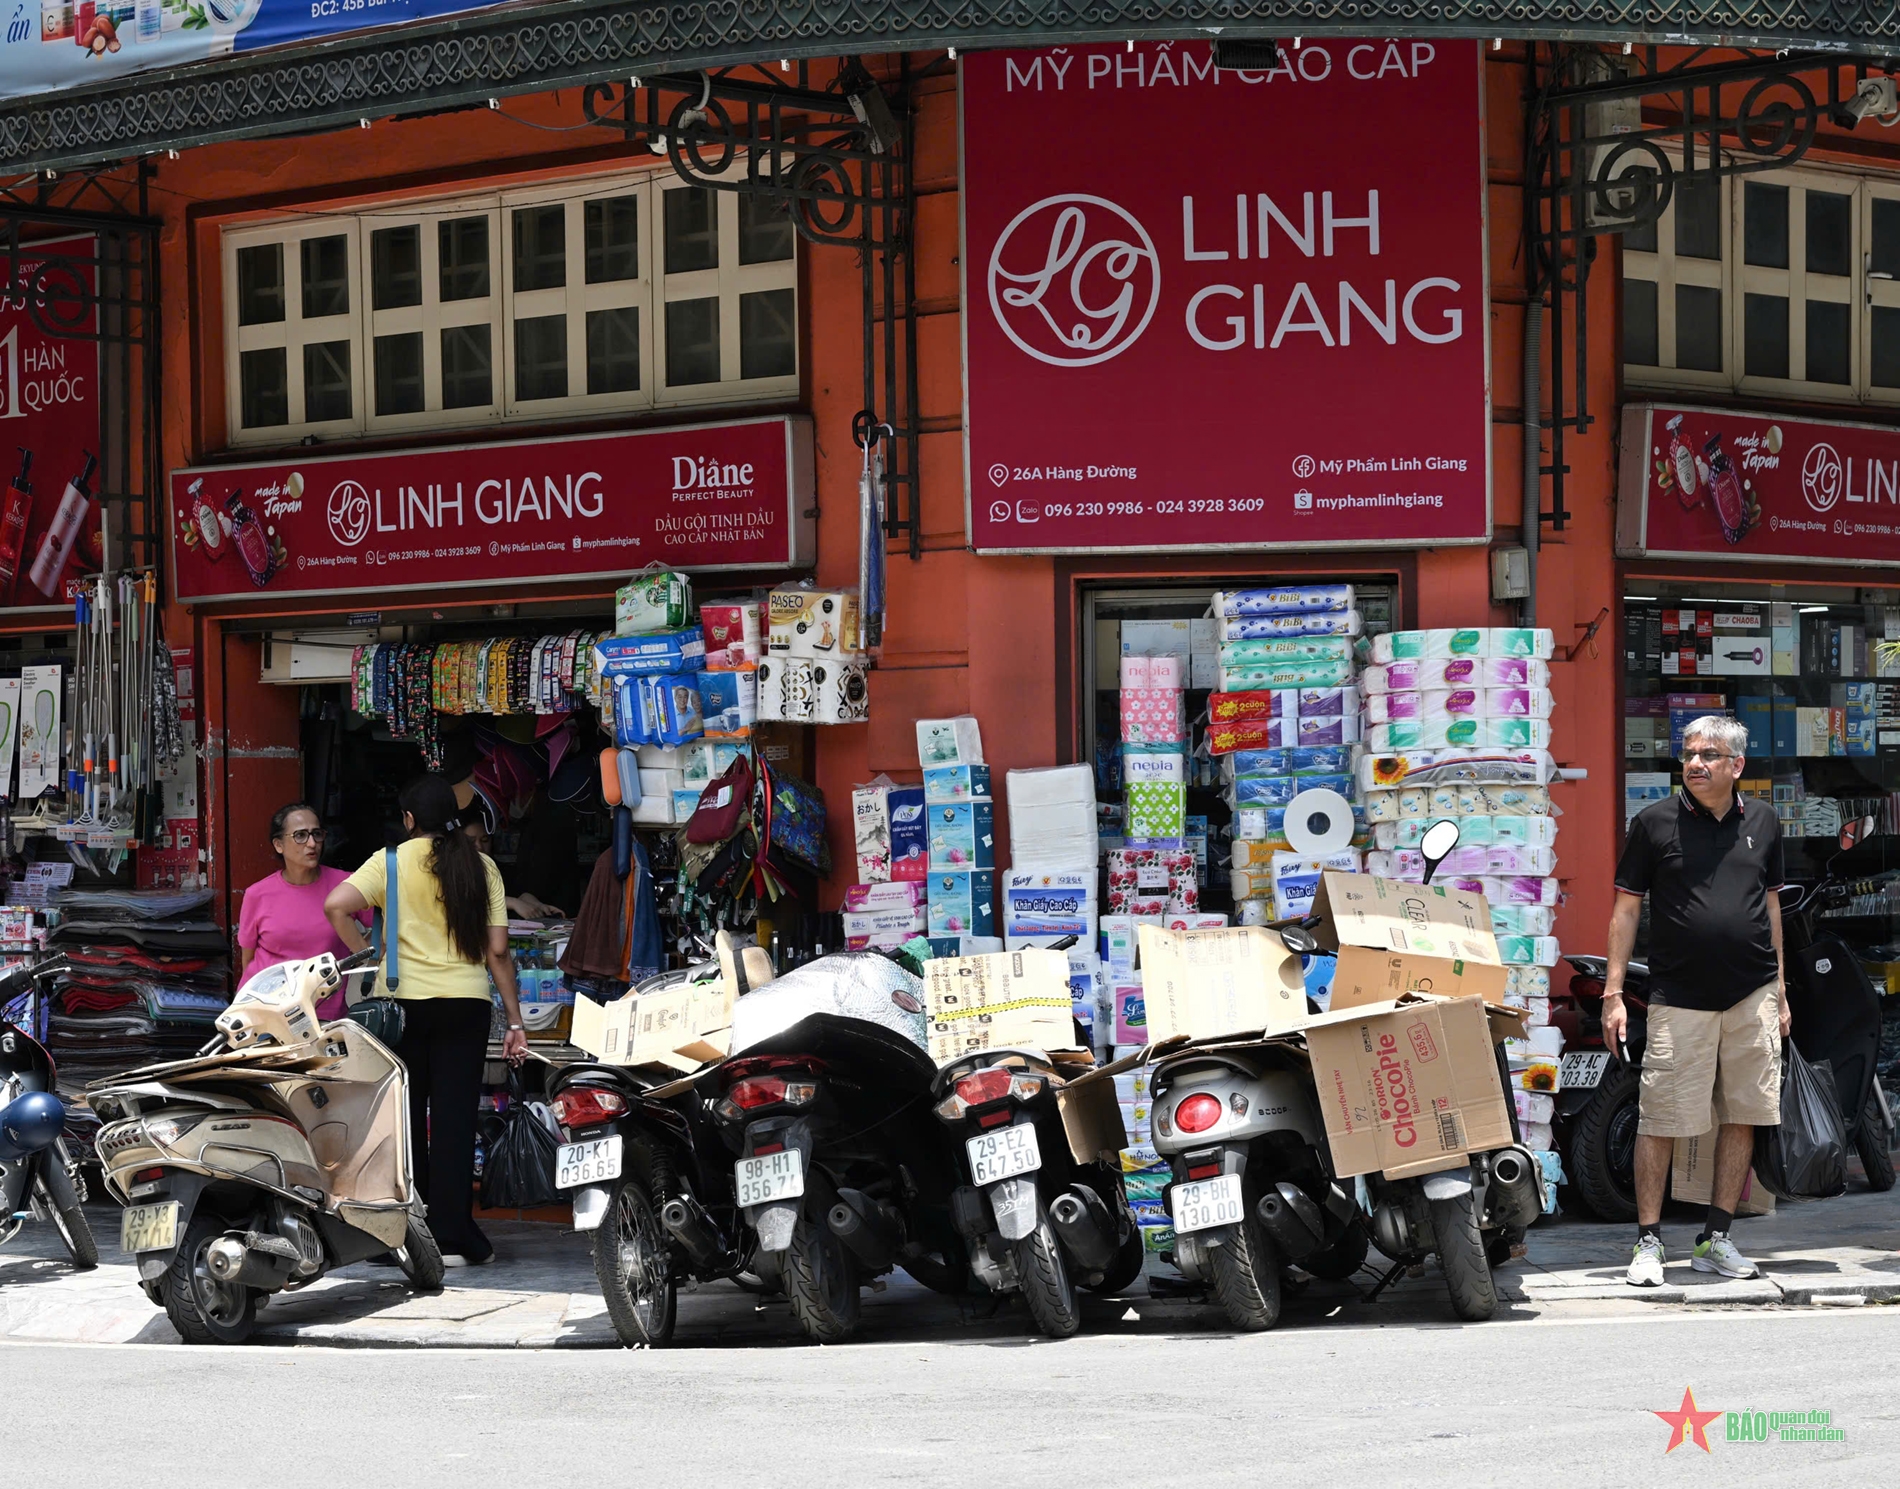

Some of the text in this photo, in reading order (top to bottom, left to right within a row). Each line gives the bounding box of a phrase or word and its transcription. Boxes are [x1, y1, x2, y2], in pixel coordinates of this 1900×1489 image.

[311, 0, 339, 18] ĐC2:
[1005, 47, 1073, 92] MỸ
[1182, 189, 1379, 261] LINH
[1185, 277, 1463, 350] GIANG
[24, 341, 65, 372] HÀN
[25, 370, 84, 411] QUỐC
[1734, 431, 1760, 447] made
[1320, 456, 1468, 475] Mỹ Phẩm Linh Giang
[1742, 448, 1780, 474] Japan
[1013, 464, 1137, 481] 26A Hàng Đường
[1846, 457, 1900, 505] LIN
[254, 480, 280, 498] made
[672, 489, 754, 502] PERFECT BEAUTY
[263, 496, 302, 520] Japan
[375, 471, 604, 532] LINH GIANG
[1045, 503, 1073, 517] 096
[1075, 502, 1104, 516] 230
[1106, 501, 1144, 515] 9986
[1156, 500, 1184, 514] 024
[1187, 499, 1224, 513] 3928
[1228, 498, 1265, 512] 3609
[1316, 493, 1443, 510] myphamlinhgiang
[709, 513, 743, 528] TINH
[1779, 520, 1791, 529] 26A
[1854, 525, 1865, 533] 096
[1865, 525, 1876, 534] 230
[1877, 525, 1891, 534] 9986
[532, 541, 545, 551] Linh
[546, 541, 566, 552] Giang
[582, 536, 641, 548] myphamlinhgiang
[664, 533, 686, 545] CAO
[307, 557, 319, 566] 26A
[388, 552, 400, 561] 096
[401, 551, 413, 560] 230
[414, 550, 430, 559] 9986
[435, 549, 447, 557] 024
[448, 547, 464, 557] 3928
[465, 545, 481, 555] 3609
[771, 594, 804, 608] PASEO
[1279, 593, 1301, 603] BiBi
[1283, 617, 1303, 627] BiBi
[1732, 616, 1760, 625] CHAOBA
[1128, 665, 1171, 678] nepia
[1132, 761, 1173, 771] nepia
[857, 802, 881, 815] おかし
[1015, 897, 1078, 913] Khăn Giấy Cao Cấp
[1405, 898, 1428, 931] CLEAR
[1566, 1054, 1601, 1069] 29-AC
[1333, 1069, 1342, 1081] TAY
[1372, 1069, 1388, 1107] ORION
[1376, 1033, 1417, 1148] ChocoPie
[1403, 1059, 1420, 1114] Bánh ChocoPie
[1438, 1098, 1447, 1109] 12
[211, 1123, 251, 1131] LEAD
[580, 1129, 601, 1137] HONDA
[977, 1128, 1026, 1159] 29-E2
[567, 1140, 609, 1165] 20-K1
[561, 1158, 616, 1184] 036.65
[745, 1153, 790, 1180] 98-H1
[976, 1148, 1035, 1181] 647.50
[1182, 1178, 1231, 1207] 29-BH
[130, 1205, 169, 1229] 29-Y3
[1180, 1200, 1238, 1229] 130.00
[1154, 1232, 1175, 1242] AnAn
